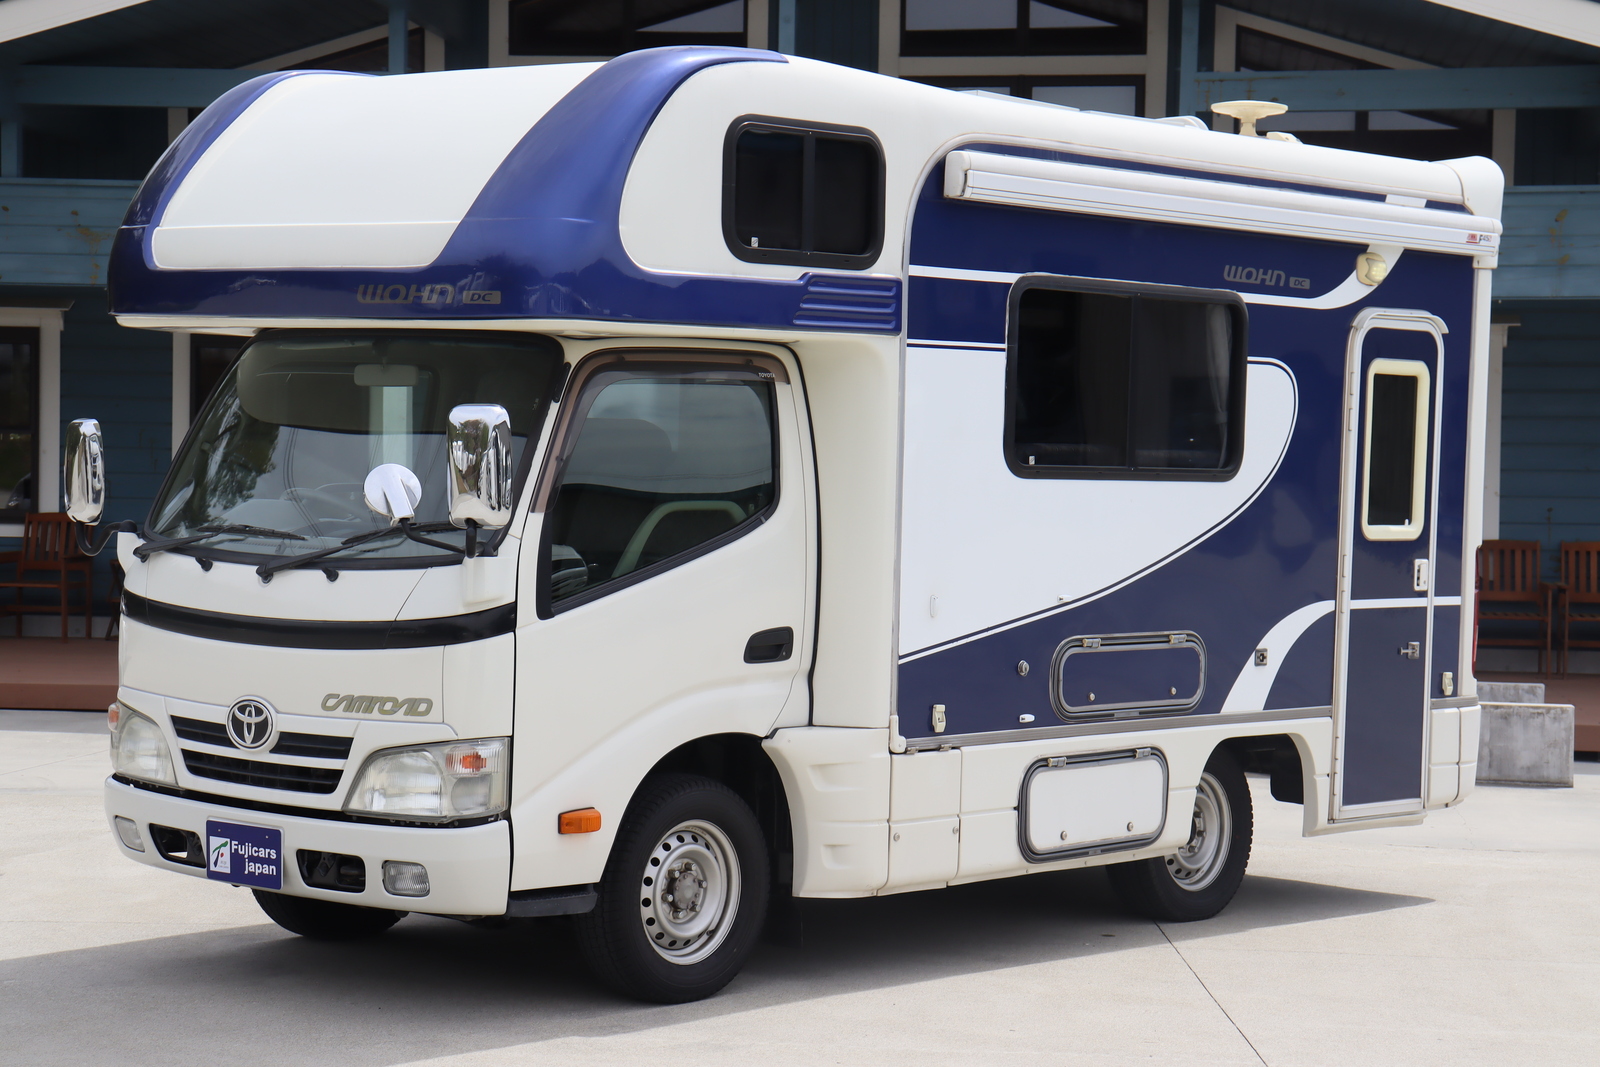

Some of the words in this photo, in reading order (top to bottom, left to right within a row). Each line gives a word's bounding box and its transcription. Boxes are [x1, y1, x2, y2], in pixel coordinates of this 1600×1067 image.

[469, 292, 493, 302] DC
[321, 693, 434, 716] CAMROAD
[231, 840, 277, 859] Fujicars
[244, 859, 276, 876] japan
